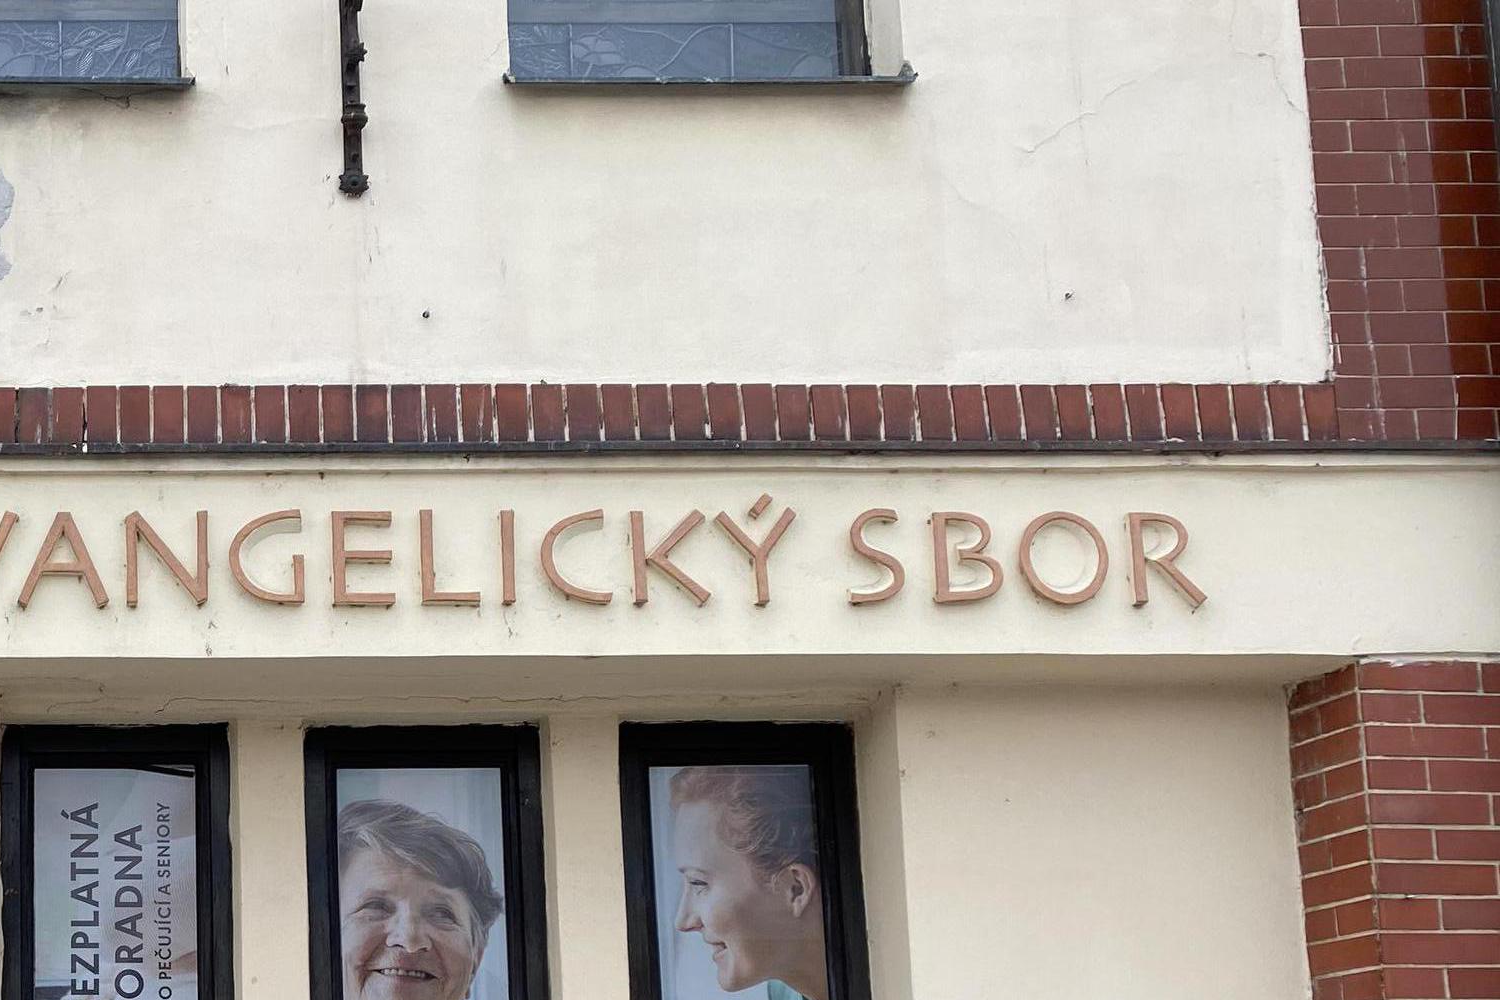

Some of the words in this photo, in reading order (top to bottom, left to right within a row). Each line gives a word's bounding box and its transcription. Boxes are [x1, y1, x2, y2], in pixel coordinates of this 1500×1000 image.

[846, 506, 1208, 610] SBOR
[156, 802, 171, 878] SENIORY
[157, 883, 171, 896] A
[154, 898, 172, 980] PEČUJÍCÍ
